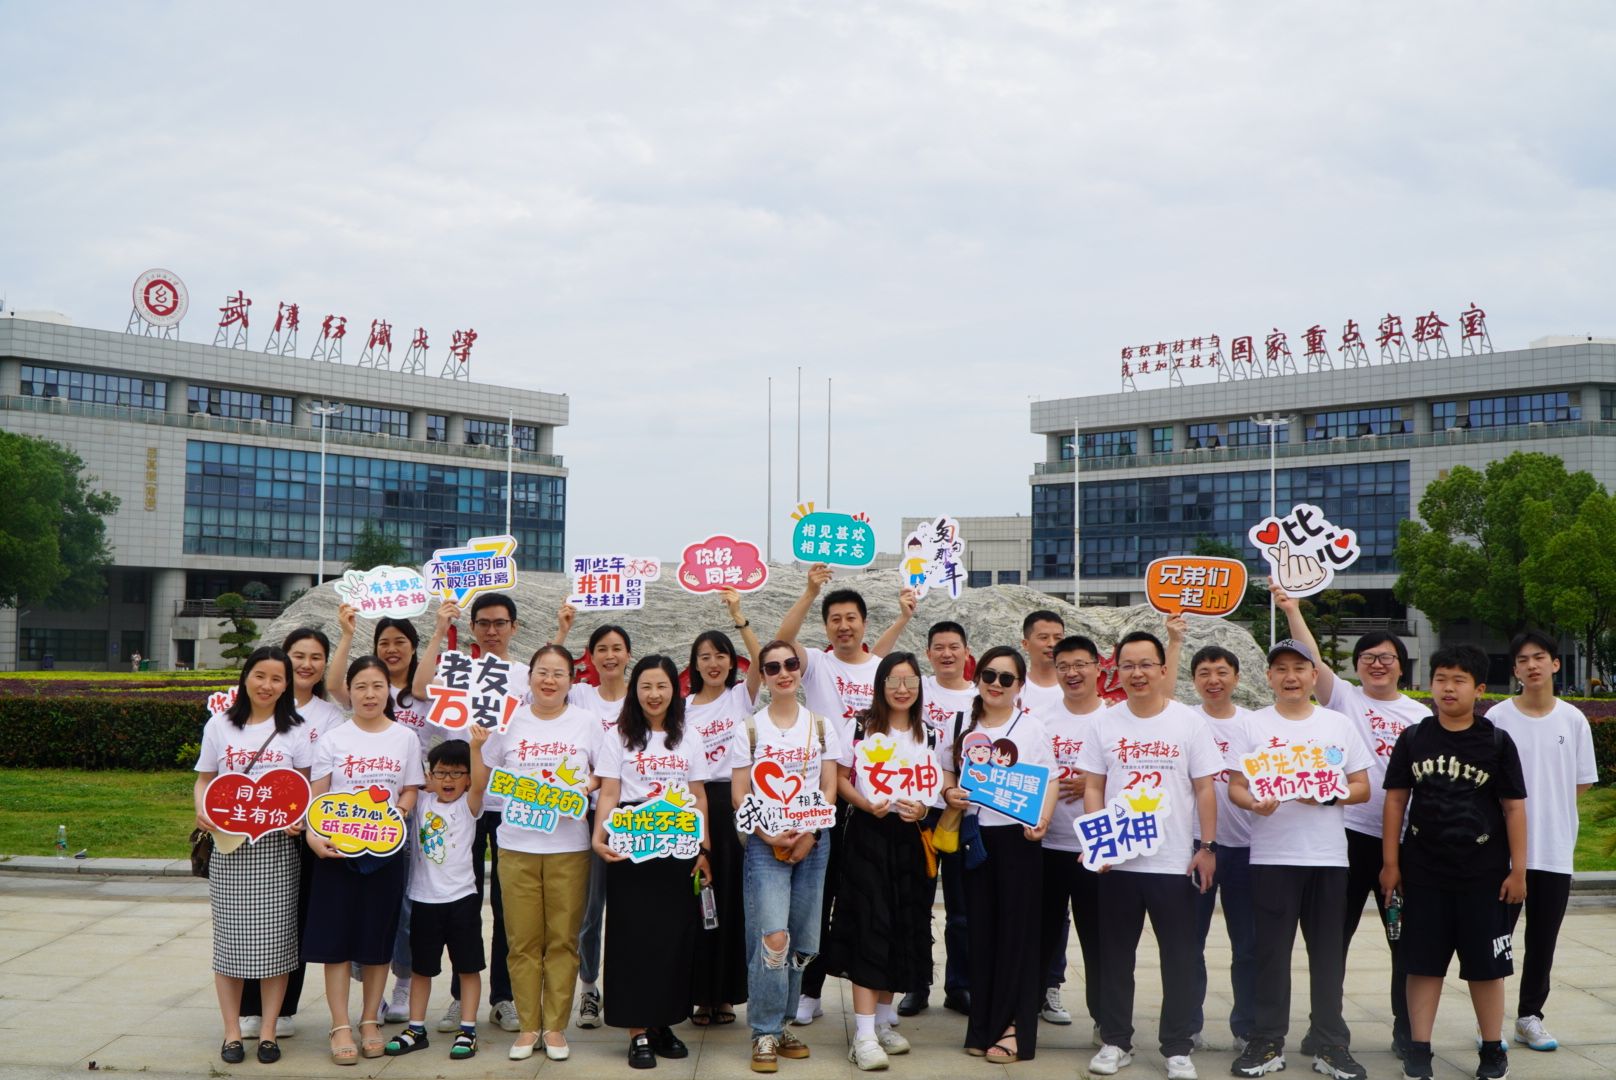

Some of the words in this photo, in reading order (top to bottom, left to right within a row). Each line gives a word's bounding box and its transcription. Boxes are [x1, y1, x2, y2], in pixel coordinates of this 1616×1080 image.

[1231, 302, 1486, 363] 国家重点实验室
[1121, 333, 1220, 360] 纺织新材料与
[1121, 352, 1221, 377] 先进加工技术
[802, 523, 866, 542] 相见甚欢
[1281, 508, 1354, 565] 比心
[695, 547, 733, 566] 你好
[800, 540, 865, 559] 相离不忘
[431, 556, 508, 574] 不输给时间
[575, 557, 625, 574] 那些年
[705, 566, 743, 584] 同学
[1159, 564, 1232, 587] 兄弟们
[369, 576, 424, 595] 有幸遇见
[431, 572, 509, 590] 不败给距离
[577, 574, 620, 594] 我们
[626, 579, 641, 606] 的岁月
[361, 592, 426, 611] 刚好合拍
[571, 594, 624, 606] 一起走过
[442, 653, 510, 696] 老友
[1111, 737, 1180, 763] 青春不散场
[1245, 745, 1329, 776] 时光不老
[338, 754, 401, 778] 青春不散场
[863, 755, 938, 798] 女神
[490, 771, 583, 815] 致最好的
[989, 768, 1041, 795] 好闺蜜
[1255, 770, 1345, 798] 我们不散
[235, 785, 272, 802] 同学
[796, 791, 825, 807] 相聚
[978, 787, 1028, 813] 一辈子
[212, 804, 288, 826] 一生有你
[320, 800, 383, 820] 不忘初心
[507, 800, 553, 830] 我们
[612, 810, 696, 832] 时光不老
[739, 797, 783, 831] 我们
[782, 807, 832, 820] Together
[322, 820, 398, 843] 砥砺前行
[771, 820, 801, 832] 在一起
[613, 832, 697, 855] 我们不散
[1079, 811, 1158, 865] 男神
